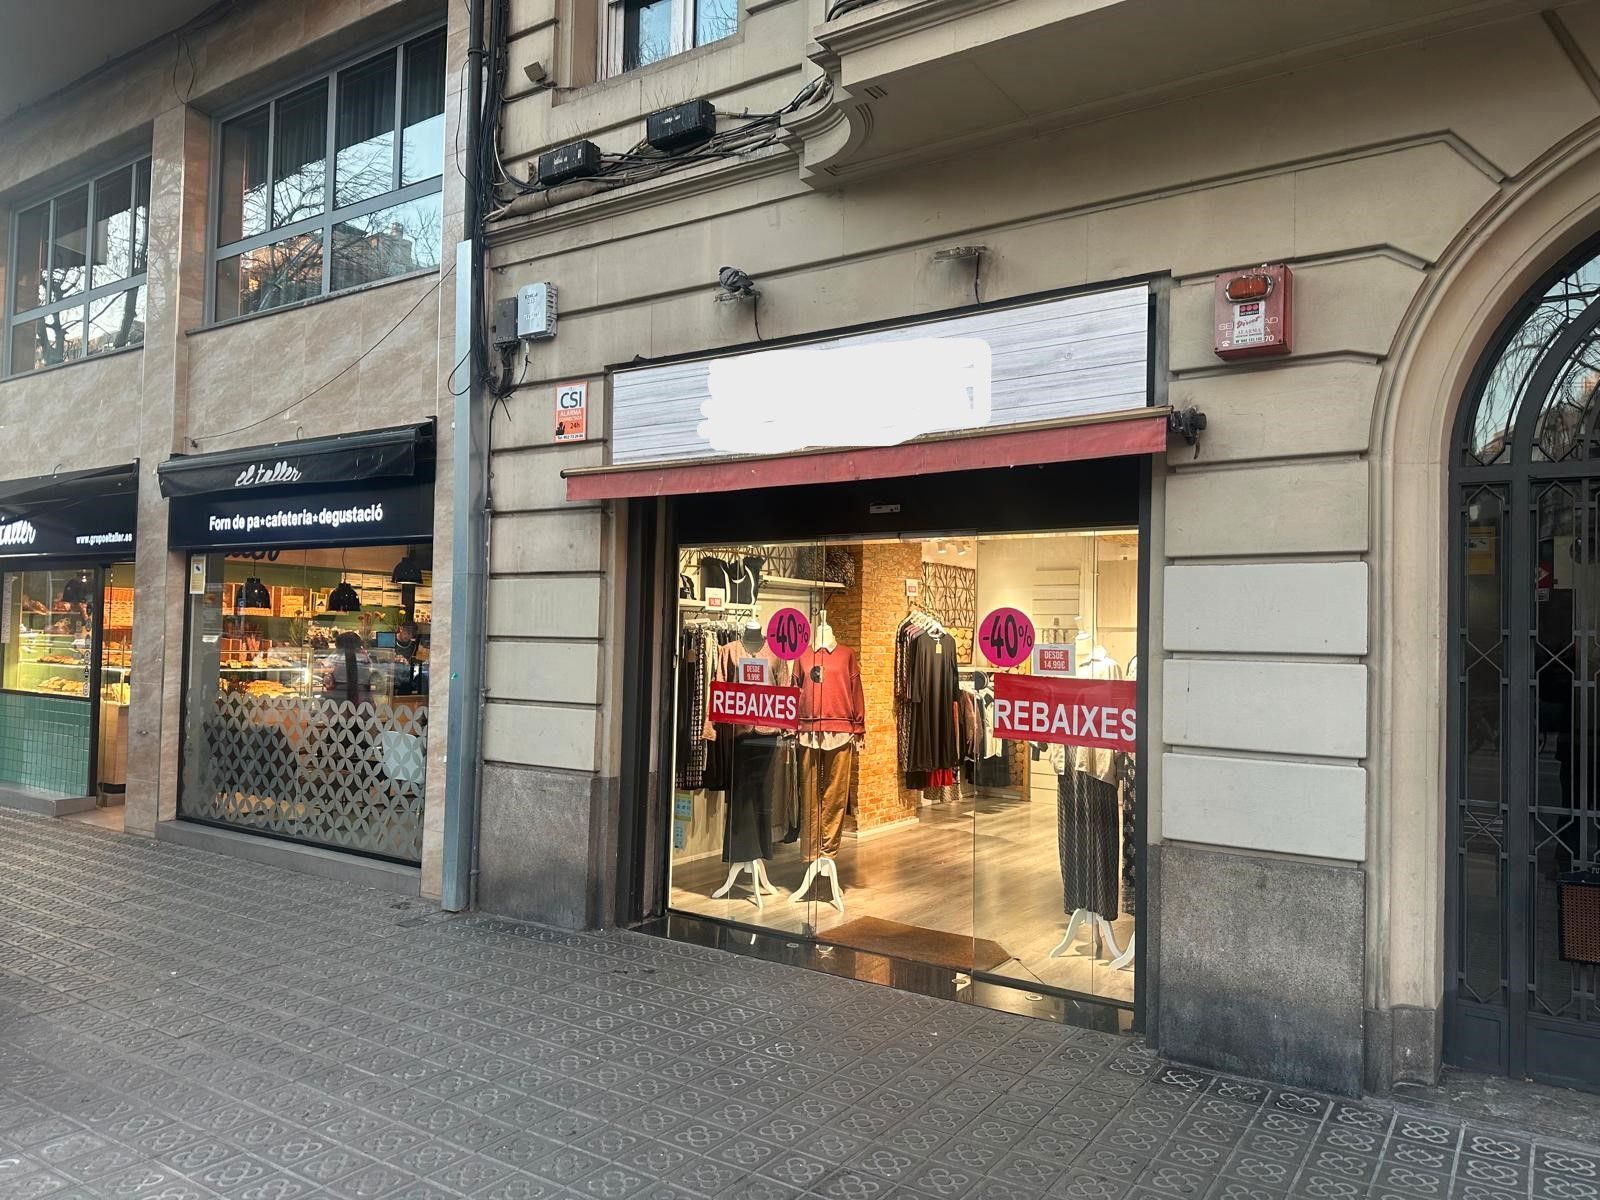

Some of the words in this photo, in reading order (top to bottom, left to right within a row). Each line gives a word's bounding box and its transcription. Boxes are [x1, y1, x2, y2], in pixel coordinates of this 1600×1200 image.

[560, 390, 582, 409] CSI
[570, 422, 581, 430] 24h
[235, 464, 254, 487] el
[254, 460, 303, 484] taller
[209, 515, 231, 531] Forn
[232, 514, 246, 530] de
[770, 613, 809, 653] -40%
[982, 614, 1033, 659] -40%
[1044, 650, 1064, 660] DESDE
[747, 665, 761, 673] DESDE
[713, 690, 797, 721] REBAIXES
[994, 698, 1136, 742] REBAIXES
